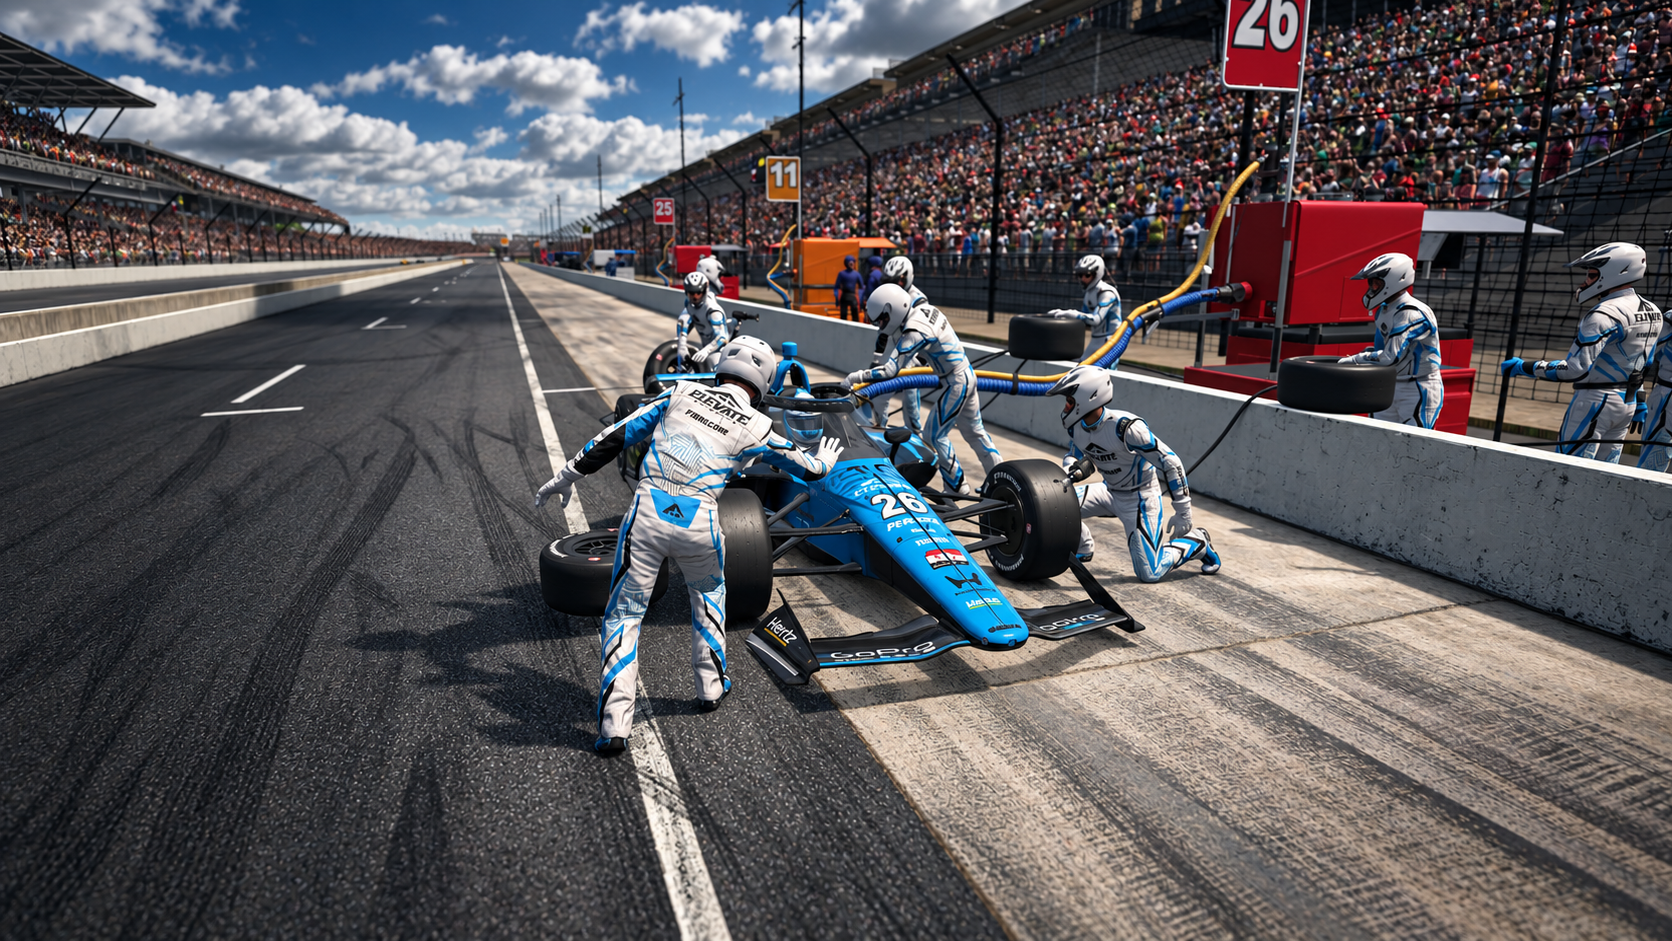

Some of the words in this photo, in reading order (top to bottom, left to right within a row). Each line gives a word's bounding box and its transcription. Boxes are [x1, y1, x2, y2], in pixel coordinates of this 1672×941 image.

[1232, 0, 1300, 52] 26
[770, 160, 798, 188] 11
[656, 201, 673, 216] 25
[870, 491, 929, 521] 26
[767, 616, 798, 645] Hertz
